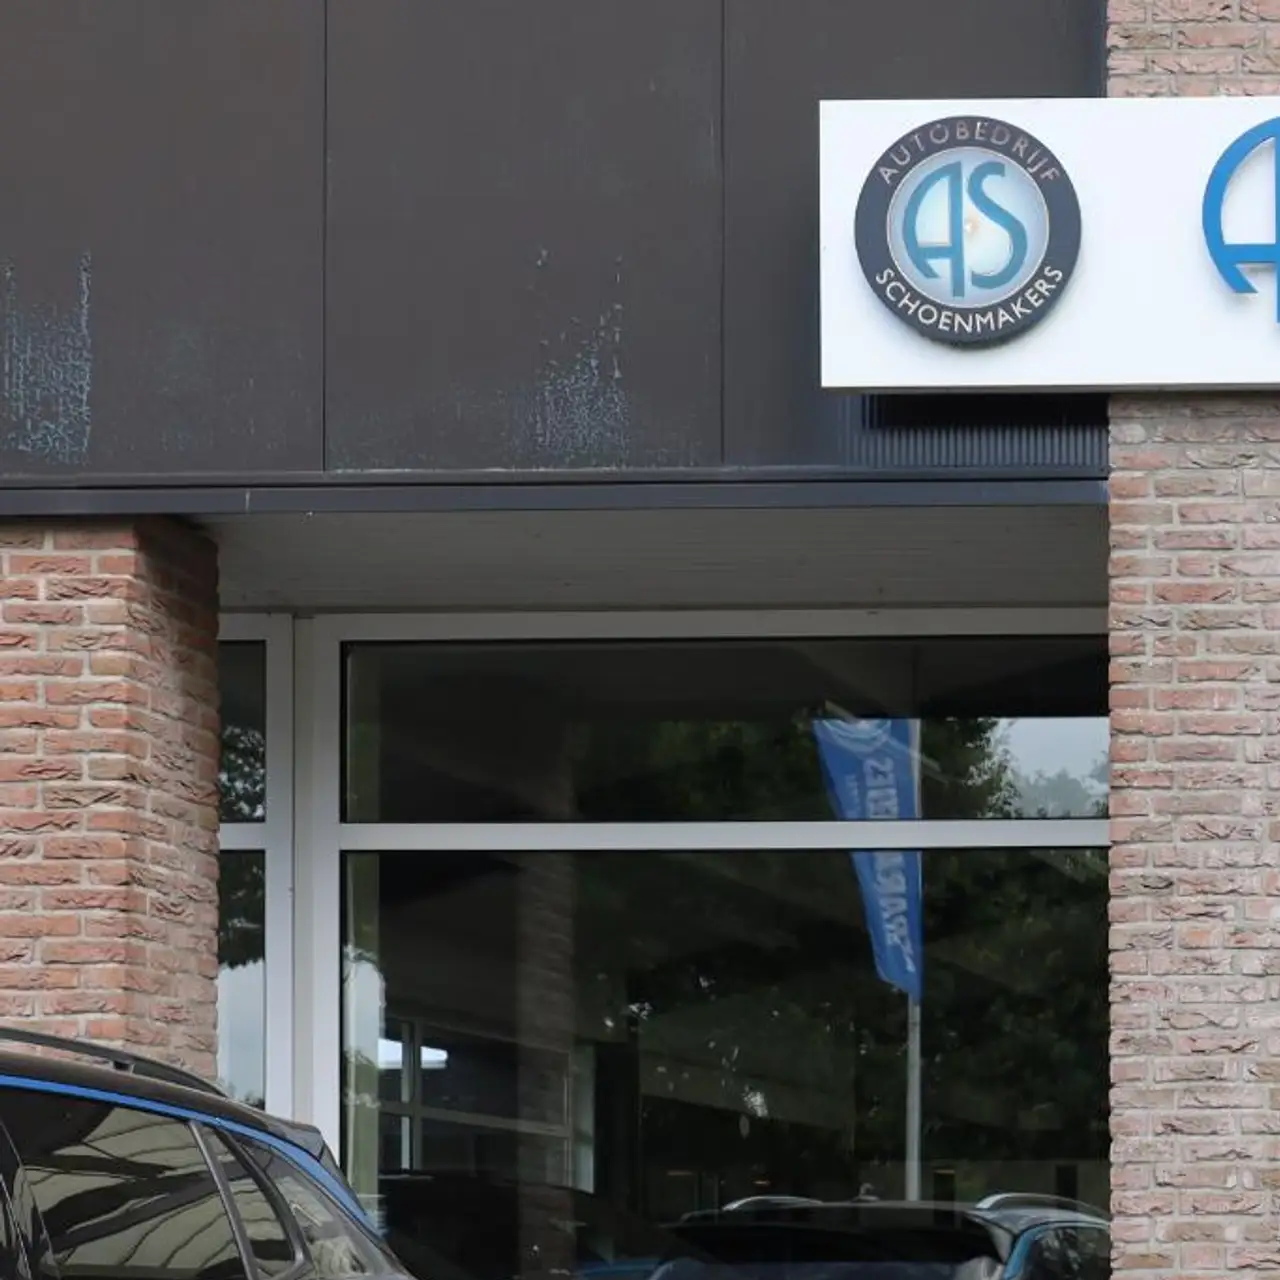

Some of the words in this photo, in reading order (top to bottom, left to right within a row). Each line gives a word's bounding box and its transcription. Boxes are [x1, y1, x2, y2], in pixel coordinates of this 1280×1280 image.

[876, 118, 1063, 187] AUTOBEDRIJF
[901, 160, 1029, 300] AS
[874, 264, 1065, 336] SCHOENMAKERS
